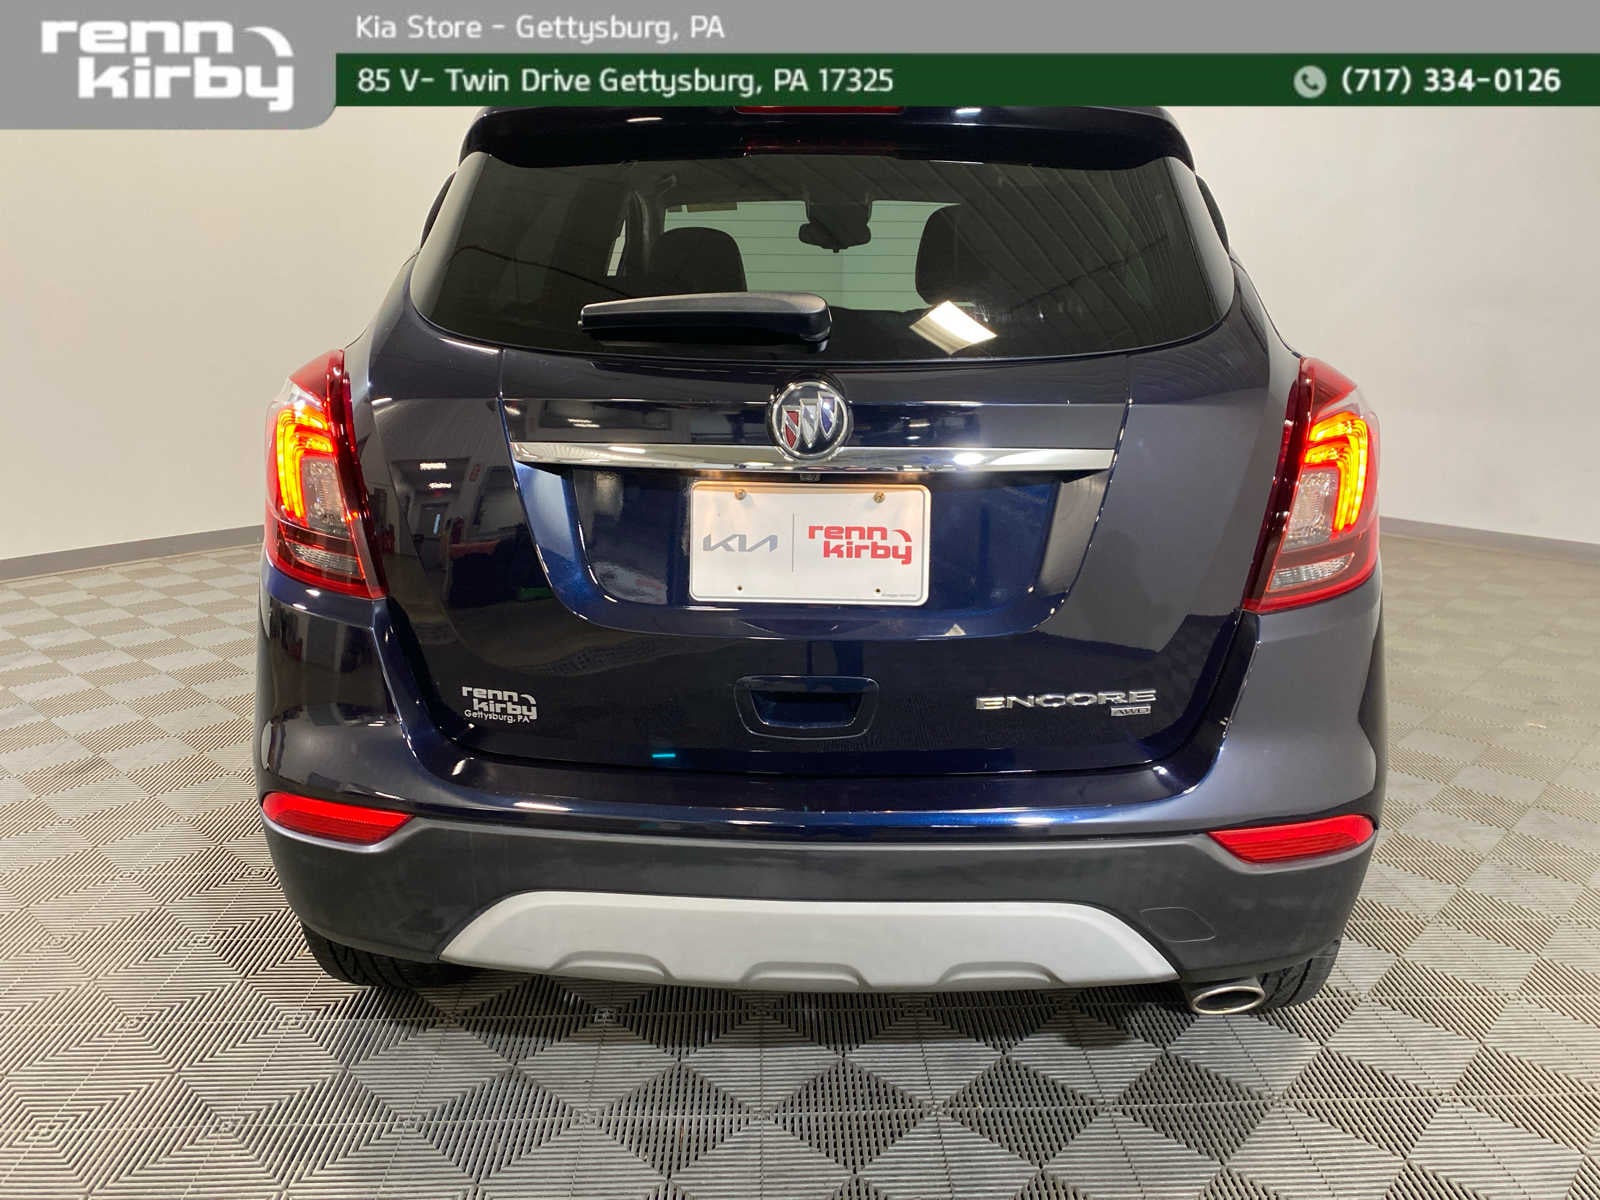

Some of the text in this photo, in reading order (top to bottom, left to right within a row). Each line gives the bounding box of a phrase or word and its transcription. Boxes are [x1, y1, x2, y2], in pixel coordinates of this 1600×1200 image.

[808, 525, 888, 541] renn
[823, 541, 913, 566] kirby
[462, 686, 519, 702] renn
[976, 689, 1157, 710] ENCORE
[464, 708, 531, 724] Gettysburg, PA
[472, 698, 537, 720] kirby
